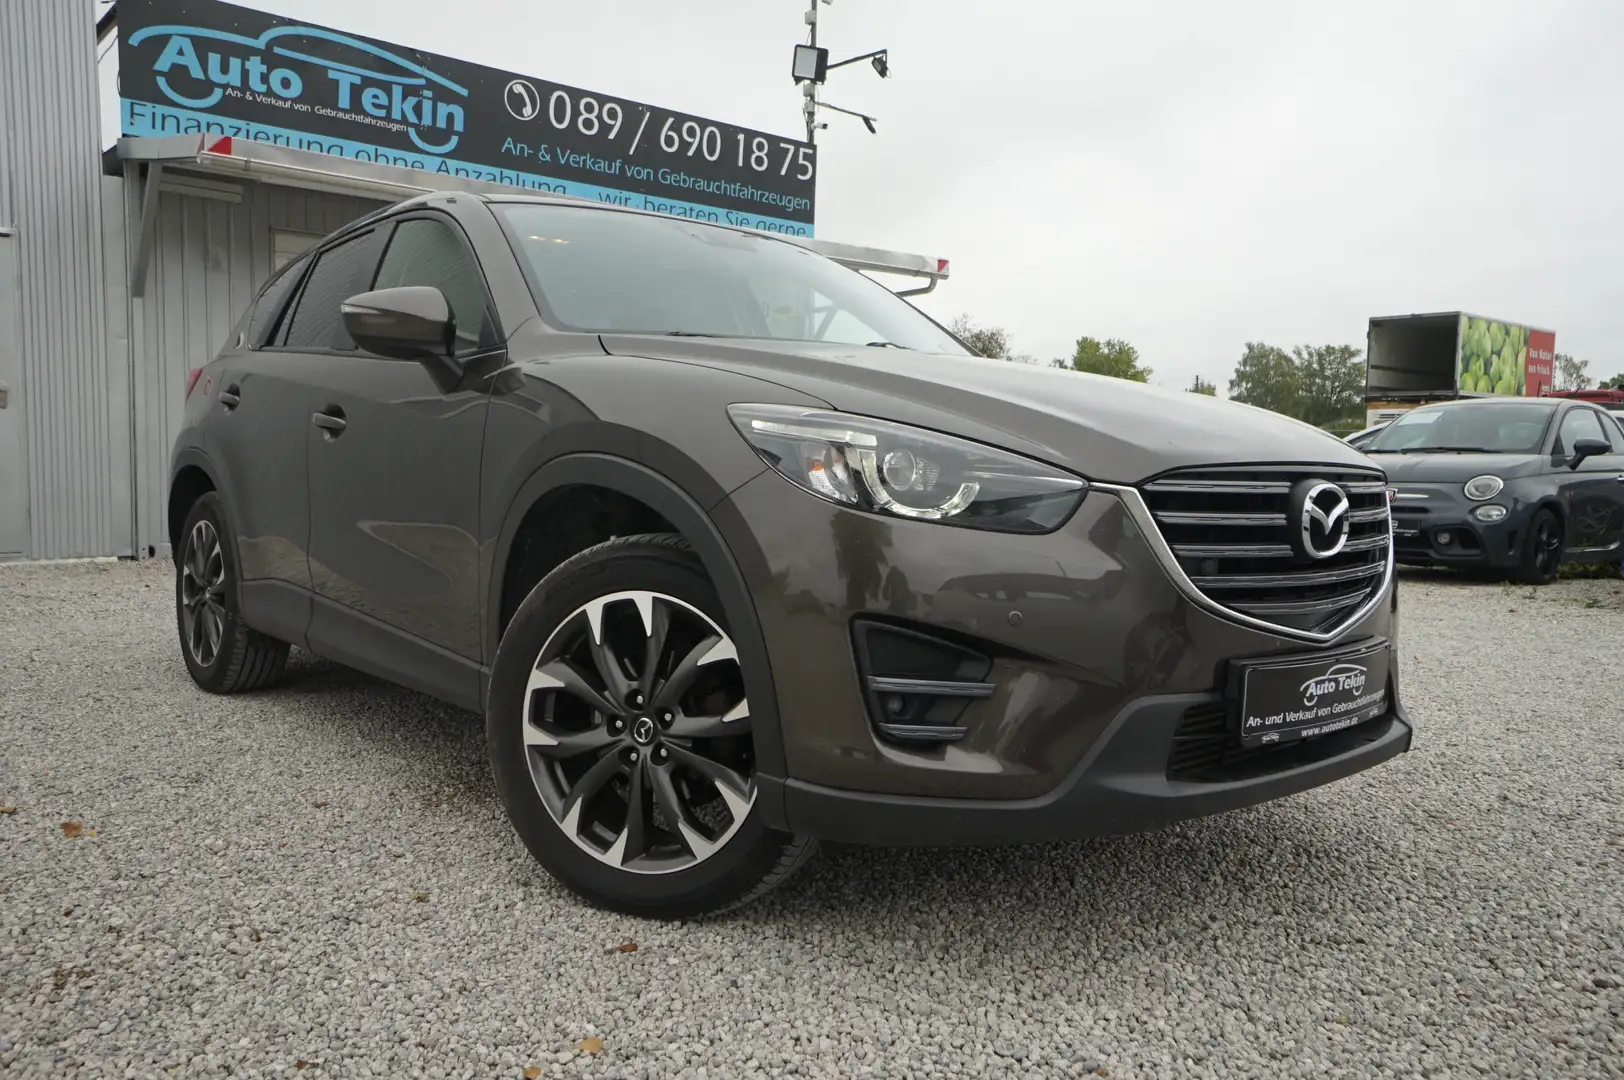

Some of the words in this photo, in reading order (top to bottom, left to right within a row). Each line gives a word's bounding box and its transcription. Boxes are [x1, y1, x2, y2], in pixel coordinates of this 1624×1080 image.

[153, 35, 303, 98] Auto
[328, 70, 465, 133] Tekin
[225, 88, 243, 98] An-
[245, 92, 253, 101] &
[255, 93, 292, 110] Verkauf
[293, 102, 311, 113] von
[315, 105, 407, 132] Gebrauchtfahrzeugen
[549, 90, 623, 140] 089
[660, 117, 722, 162] 690
[737, 133, 769, 172] 18
[779, 142, 814, 181] 75
[501, 137, 534, 158] An-
[539, 144, 552, 162] &
[556, 149, 622, 175] Verkauf
[625, 166, 653, 181] von
[658, 169, 810, 211] Gebrauchtfahrzeugen
[1306, 682, 1335, 697] Auto
[1338, 674, 1366, 691] Tekin
[1246, 716, 1263, 727] An-
[1265, 713, 1283, 725] und
[1285, 708, 1317, 722] Verkauf
[1318, 707, 1331, 717] von
[1301, 716, 1359, 737] www.autotekin.de
